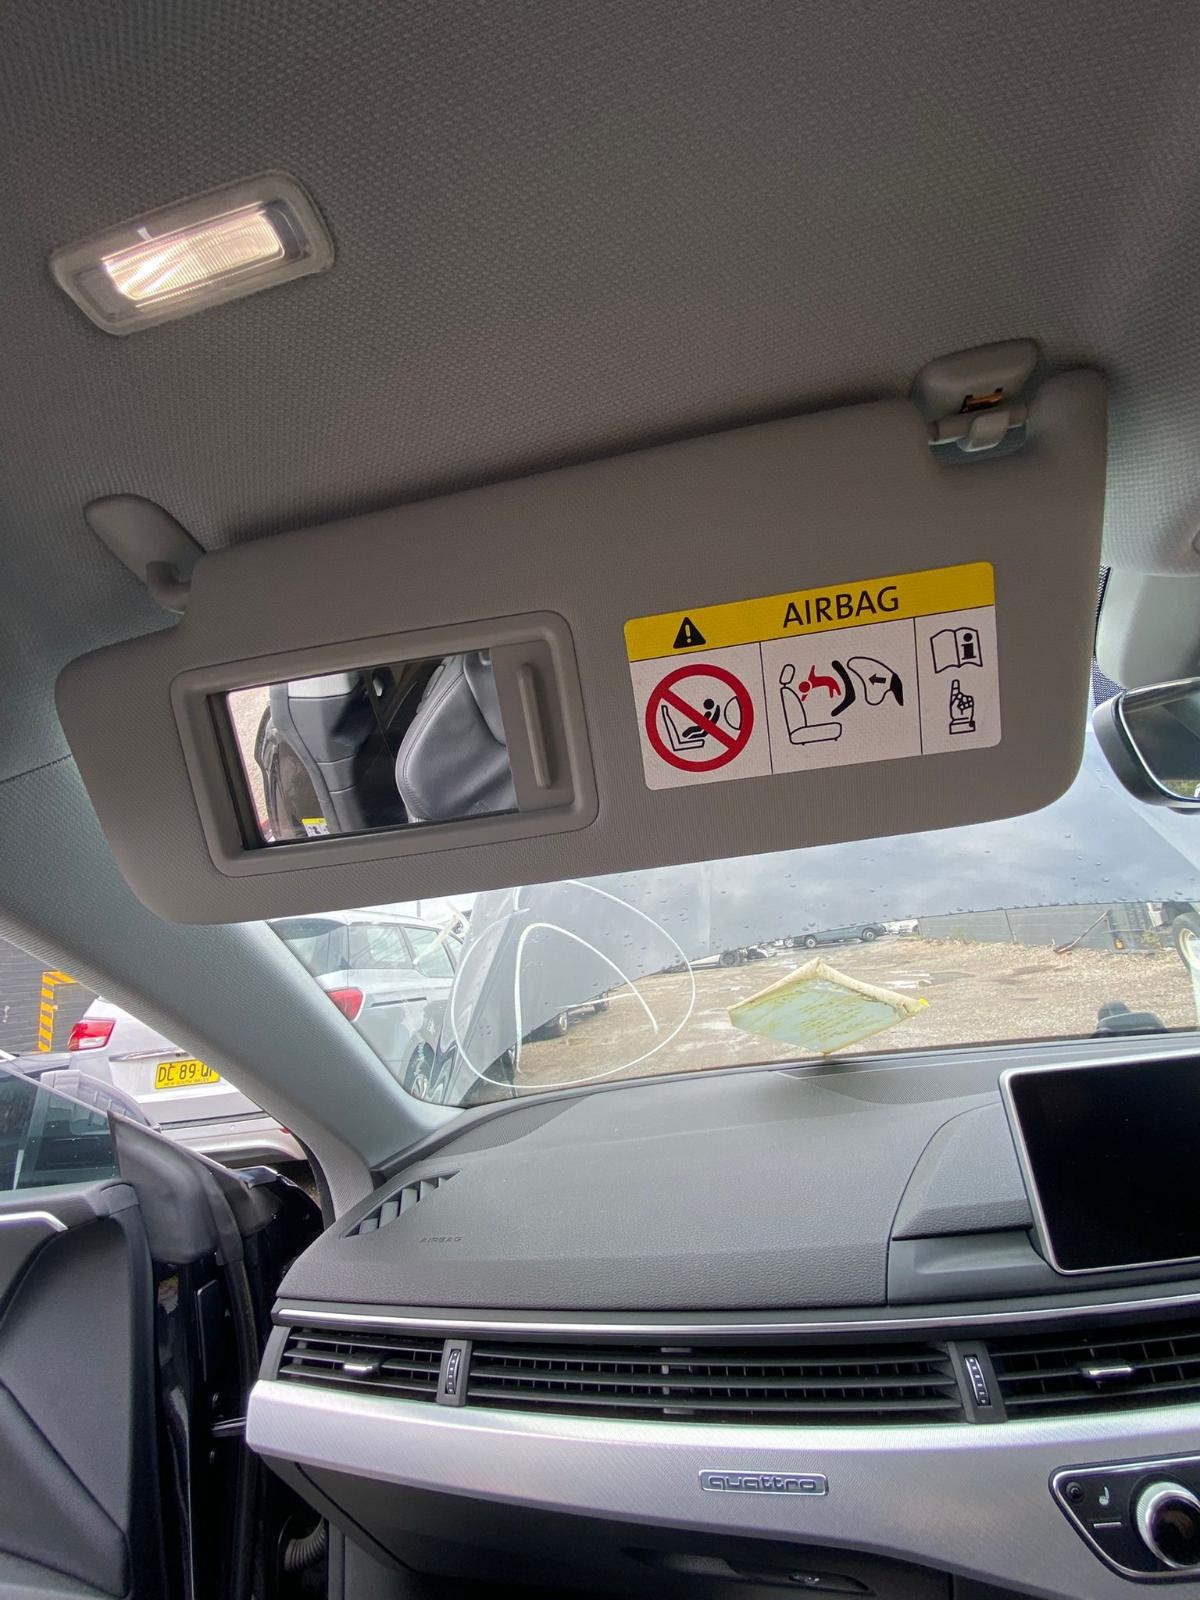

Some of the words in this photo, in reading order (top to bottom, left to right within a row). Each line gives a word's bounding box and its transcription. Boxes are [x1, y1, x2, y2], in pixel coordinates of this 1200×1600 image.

[783, 585, 900, 629] AIRBAG
[157, 1065, 175, 1082] DC
[179, 1063, 197, 1080] 89
[708, 1475, 817, 1491] quattro
